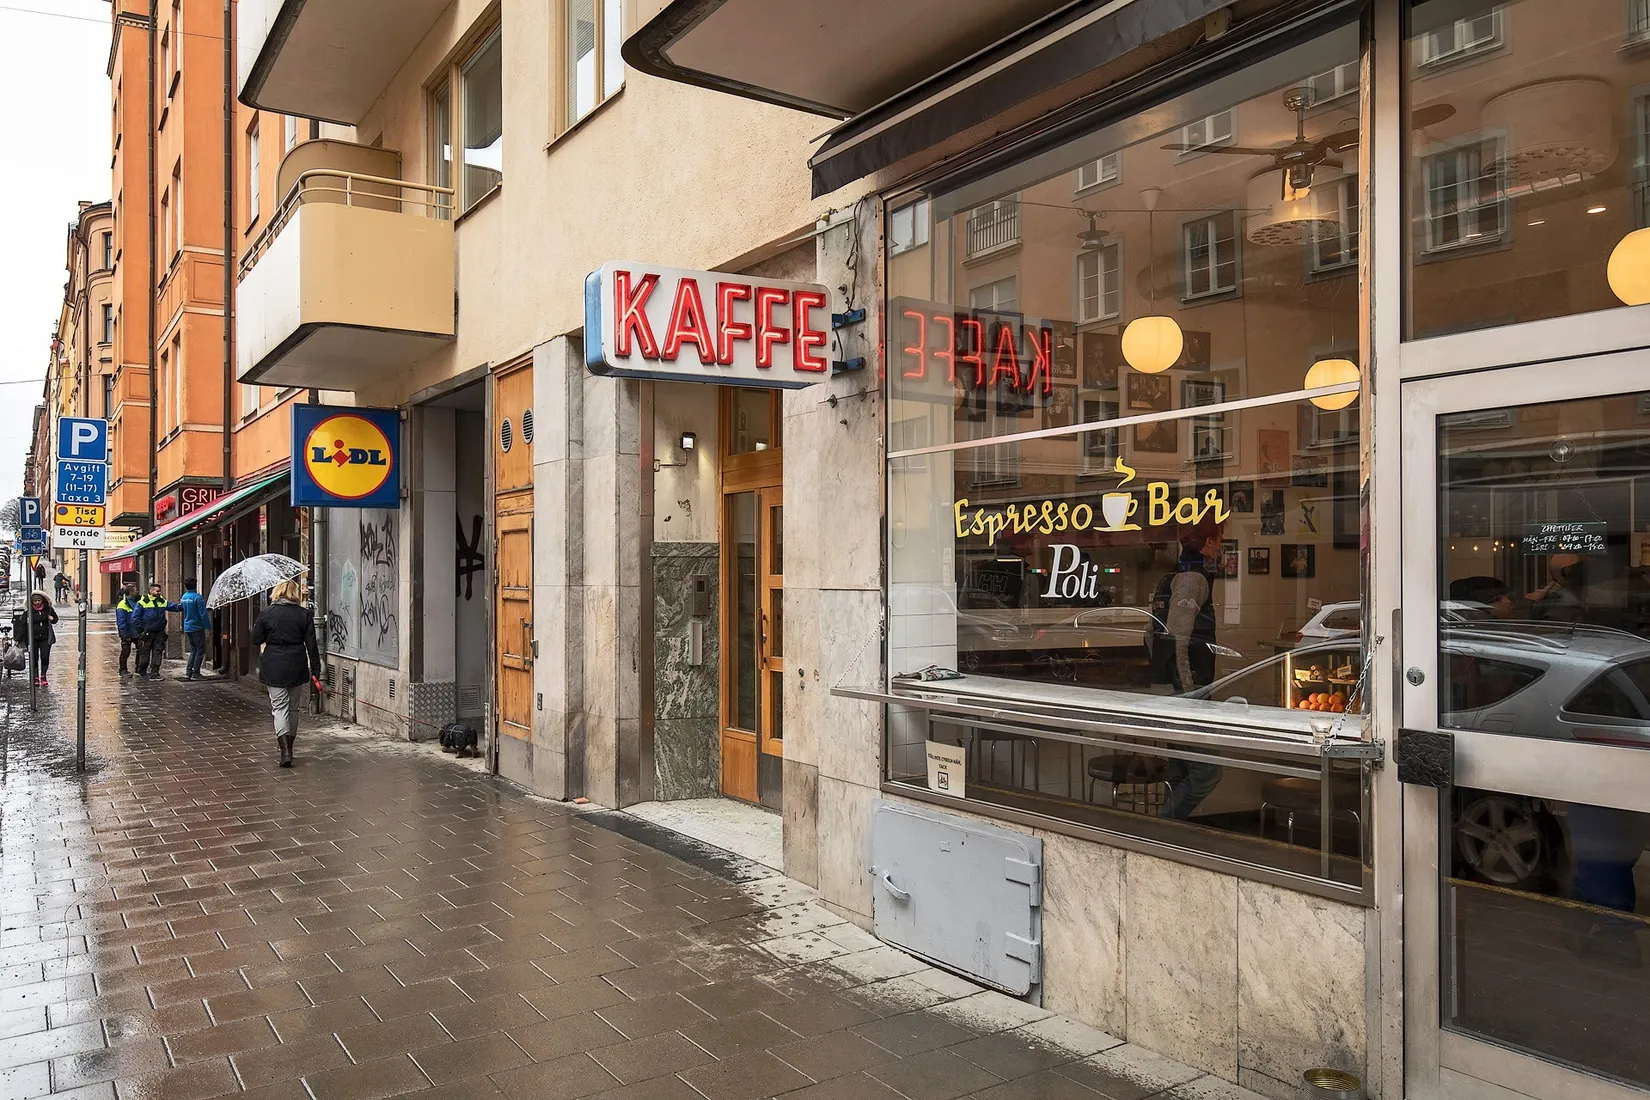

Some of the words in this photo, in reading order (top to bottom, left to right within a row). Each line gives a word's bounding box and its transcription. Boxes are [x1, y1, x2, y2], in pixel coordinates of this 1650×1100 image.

[613, 269, 827, 372] KAFFE
[71, 422, 99, 456] P
[64, 463, 100, 474] Avgift
[61, 493, 90, 502] Taxa
[95, 495, 101, 503] 3
[25, 500, 37, 523] P
[75, 507, 97, 516] Tisd
[954, 497, 1094, 547] Espresso
[1147, 481, 1231, 527] Bar
[75, 516, 96, 525] 0-6
[60, 528, 100, 538] Boende
[72, 538, 86, 546] Ku
[1040, 543, 1100, 600] Poli
